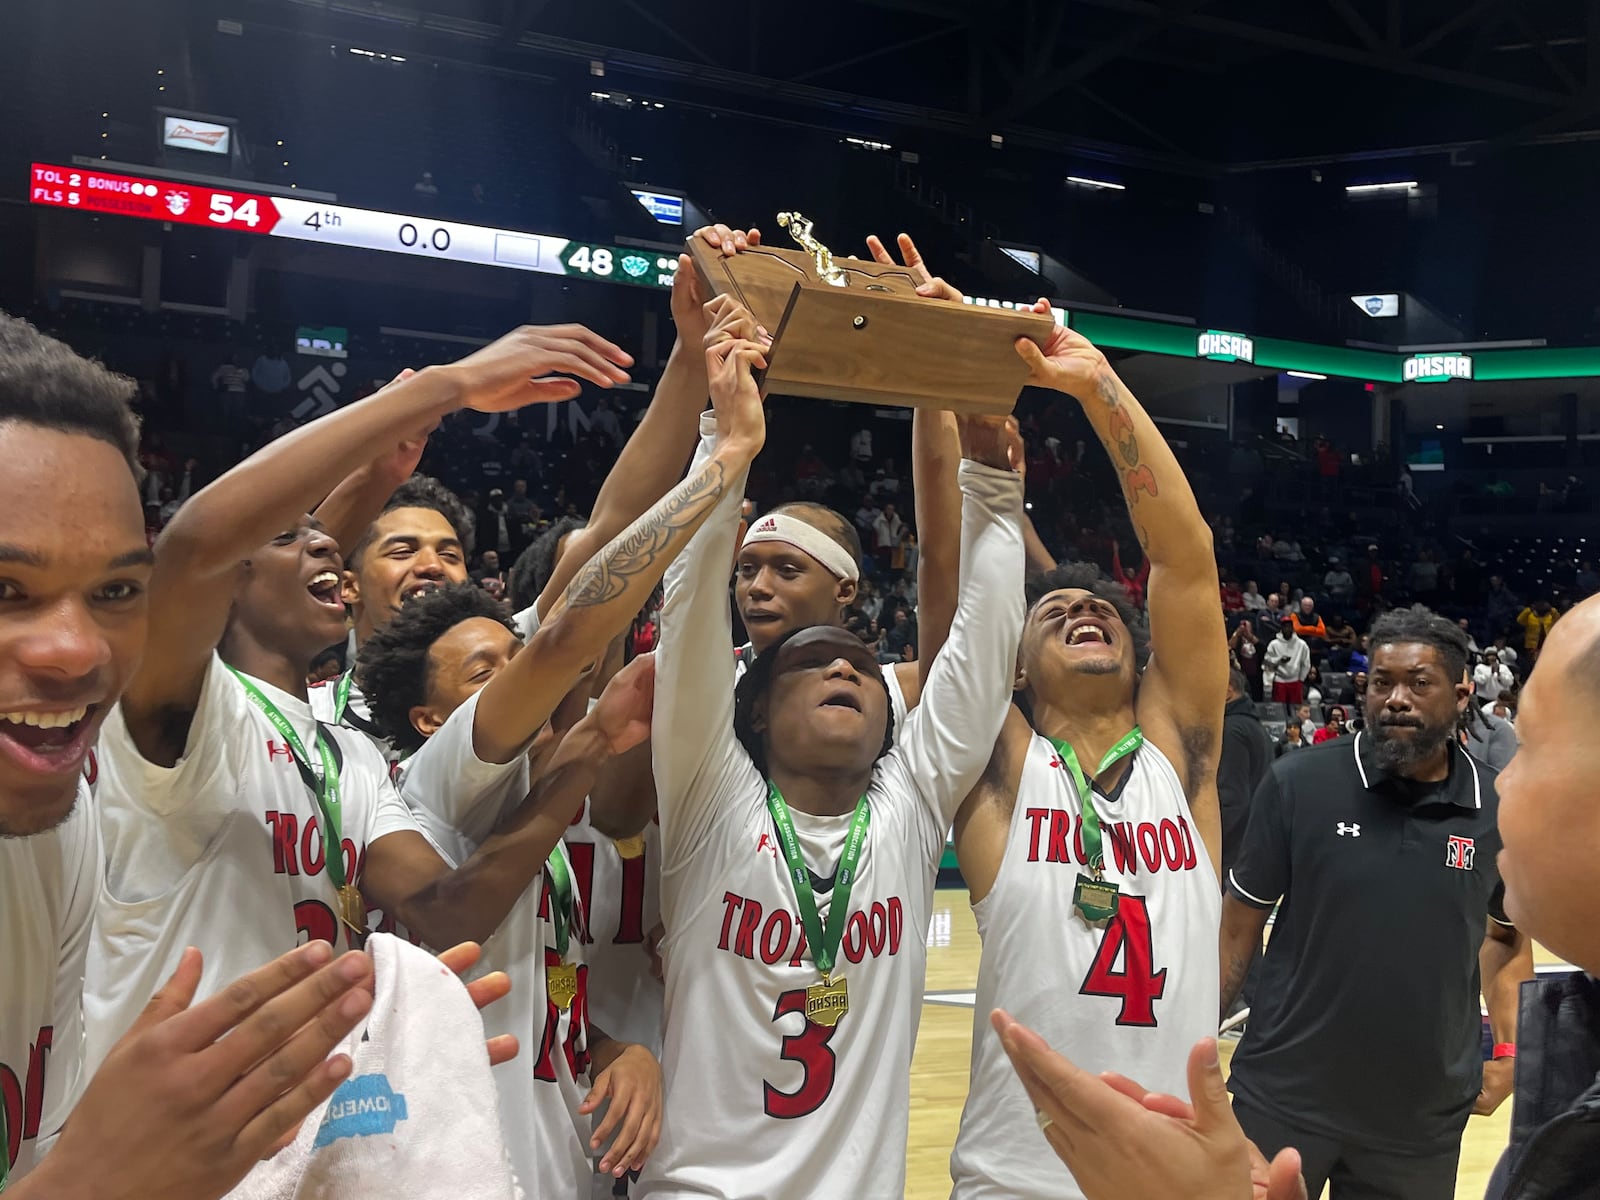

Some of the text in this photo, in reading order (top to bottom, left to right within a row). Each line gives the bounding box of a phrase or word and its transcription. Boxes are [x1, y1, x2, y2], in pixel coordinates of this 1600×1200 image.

[34, 169, 81, 187] TOL 2
[87, 177, 131, 193] BONUS
[33, 188, 80, 205] FLS 5
[208, 193, 260, 227] 54
[303, 210, 342, 232] 4th
[399, 222, 450, 252] 0.0
[568, 246, 613, 276] 48
[1198, 333, 1253, 363] OHSAA
[1404, 356, 1472, 381] OHSAA
[1026, 807, 1198, 876] TRWOOD
[717, 891, 904, 967] TROTOOD
[1078, 892, 1168, 1027] 4
[808, 994, 847, 1013] OHSAA
[763, 989, 837, 1120] 3
